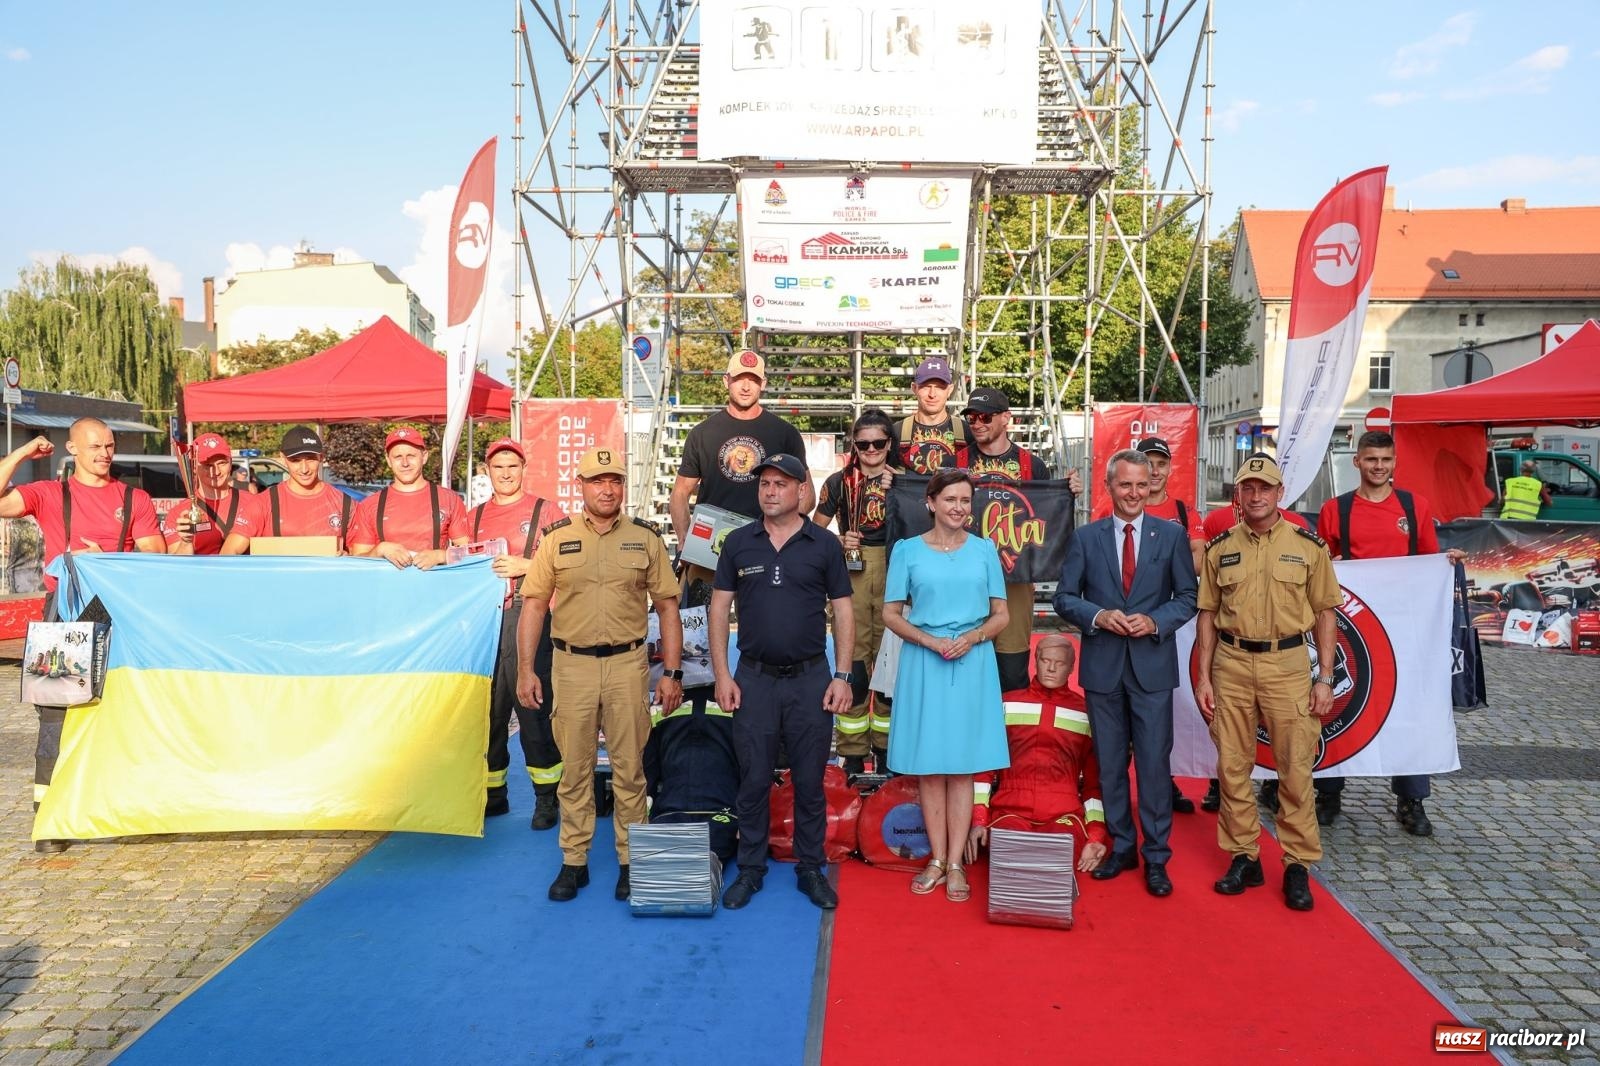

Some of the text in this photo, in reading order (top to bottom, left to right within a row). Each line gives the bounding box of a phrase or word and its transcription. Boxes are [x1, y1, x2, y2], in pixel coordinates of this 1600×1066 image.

[806, 122, 925, 138] WWW.ARPAPOL.PL
[833, 210, 854, 218] POLICE
[863, 210, 877, 218] FIRE
[829, 246, 891, 255] KAMPKA
[881, 276, 940, 288] KAREN
[846, 320, 893, 328] TECHNOLOGY
[558, 415, 572, 514] REKORD
[988, 491, 1011, 500] FCC
[1325, 718, 1344, 735] Lviv
